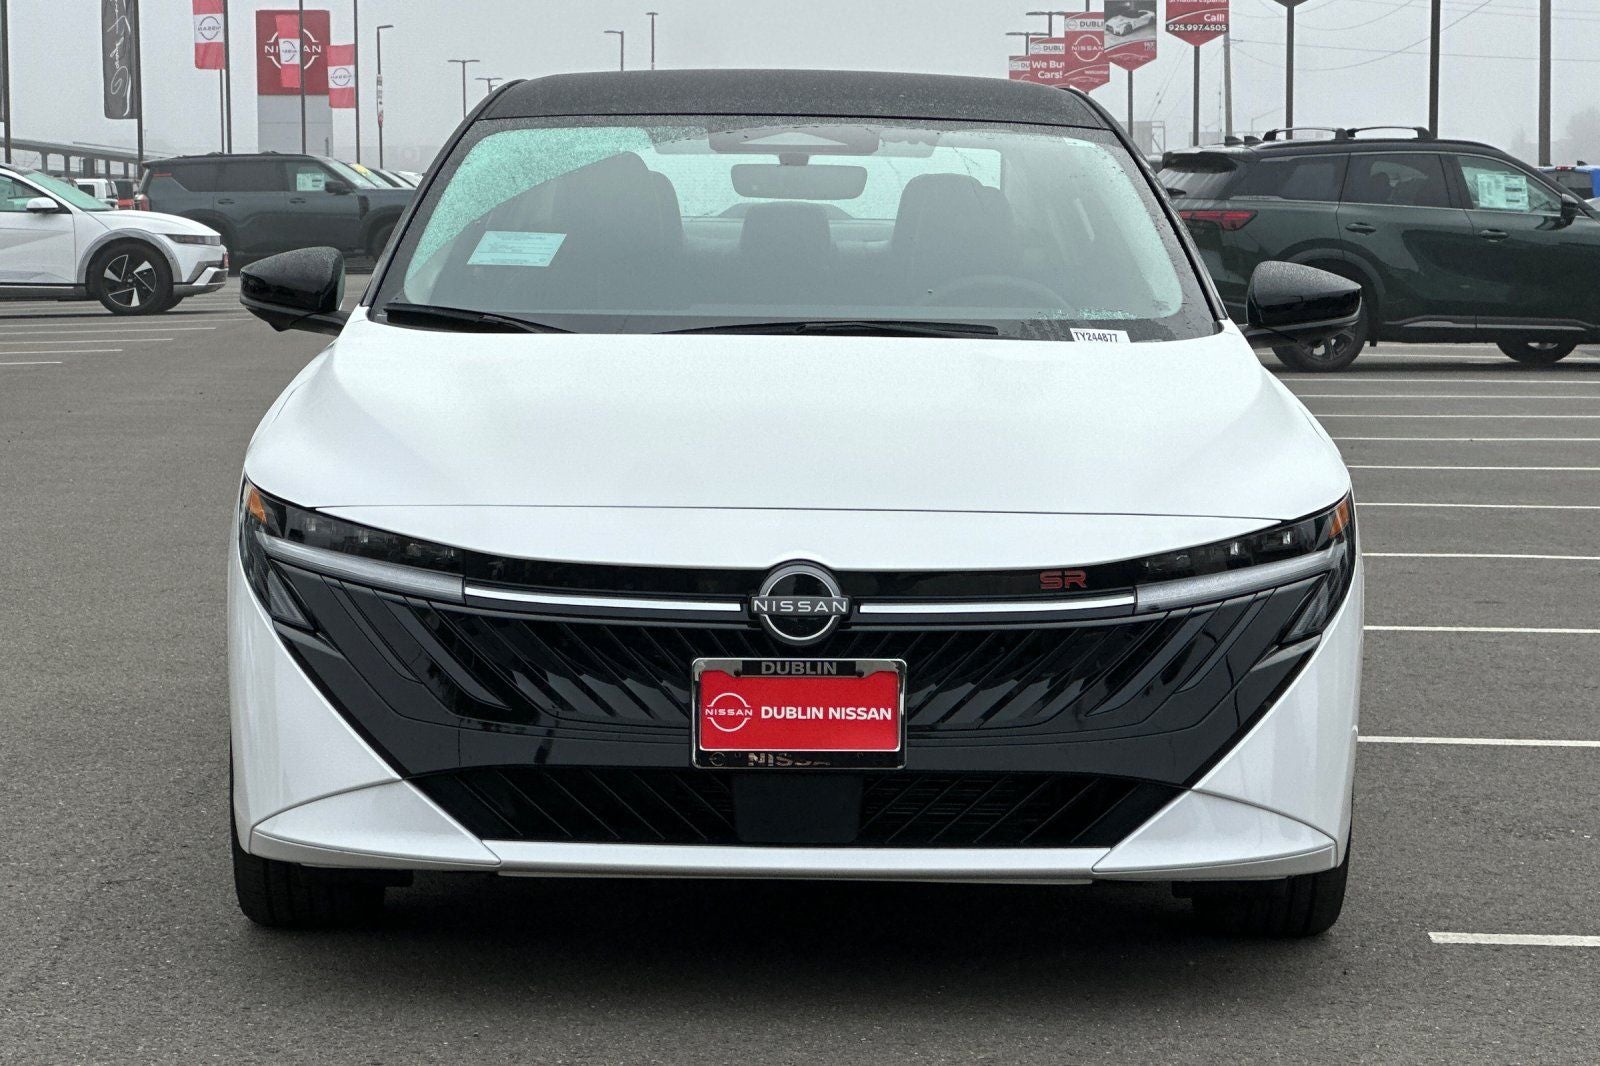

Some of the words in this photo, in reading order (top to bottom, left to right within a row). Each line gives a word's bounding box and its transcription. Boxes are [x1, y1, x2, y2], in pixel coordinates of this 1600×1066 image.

[1204, 13, 1225, 22] Call!
[1079, 20, 1104, 28] DUBLI
[1168, 23, 1227, 31] 925.997.4505
[264, 45, 322, 53] NIAN
[1031, 60, 1047, 69] We
[1037, 71, 1063, 79] Cars!
[1074, 332, 1118, 342] TY244877
[1039, 569, 1087, 590] SR
[753, 600, 848, 614] NISSAN
[761, 661, 837, 675] DUBLIN
[705, 708, 753, 716] NISSAN
[761, 706, 824, 720] DUBLIN
[829, 707, 892, 720] NISSAN
[747, 752, 831, 767] NIS
